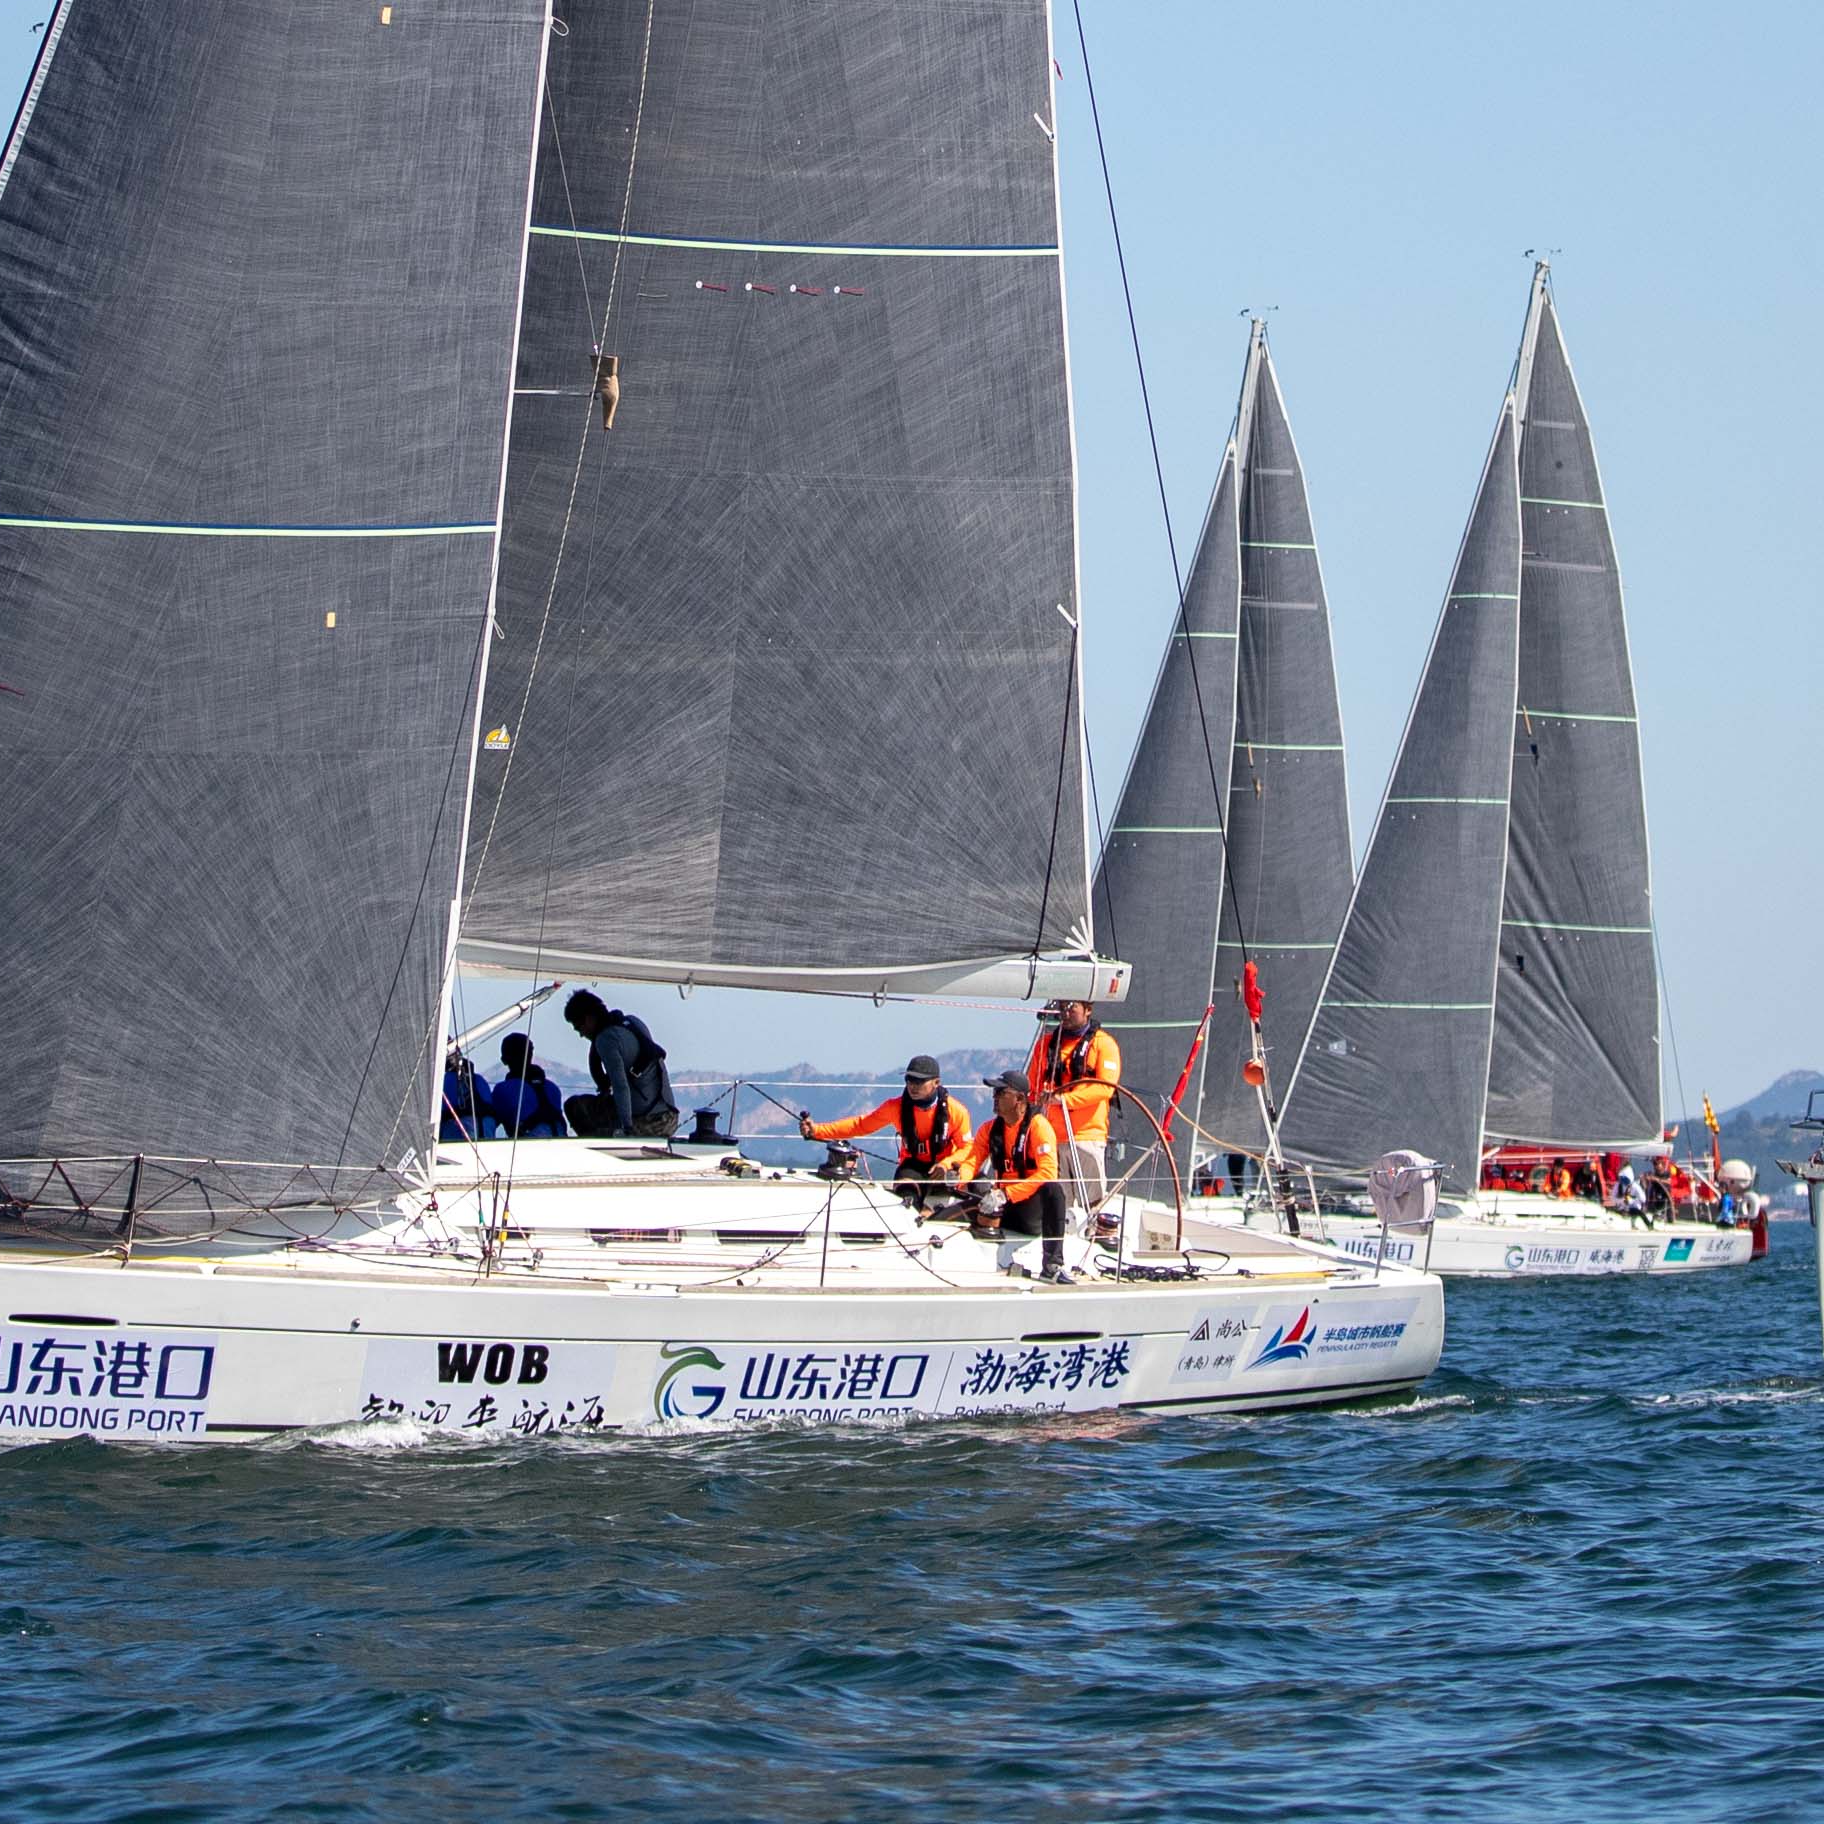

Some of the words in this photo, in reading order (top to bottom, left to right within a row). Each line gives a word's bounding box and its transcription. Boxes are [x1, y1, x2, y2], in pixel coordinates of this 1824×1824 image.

[1216, 1319, 1248, 1339] 尚公
[1323, 1323, 1407, 1343] 半岛城市帆船赛
[438, 1342, 550, 1385] WOB
[739, 1353, 929, 1400] 山东港口
[960, 1341, 1130, 1396] 渤海湾港
[127, 1409, 205, 1433] PORT
